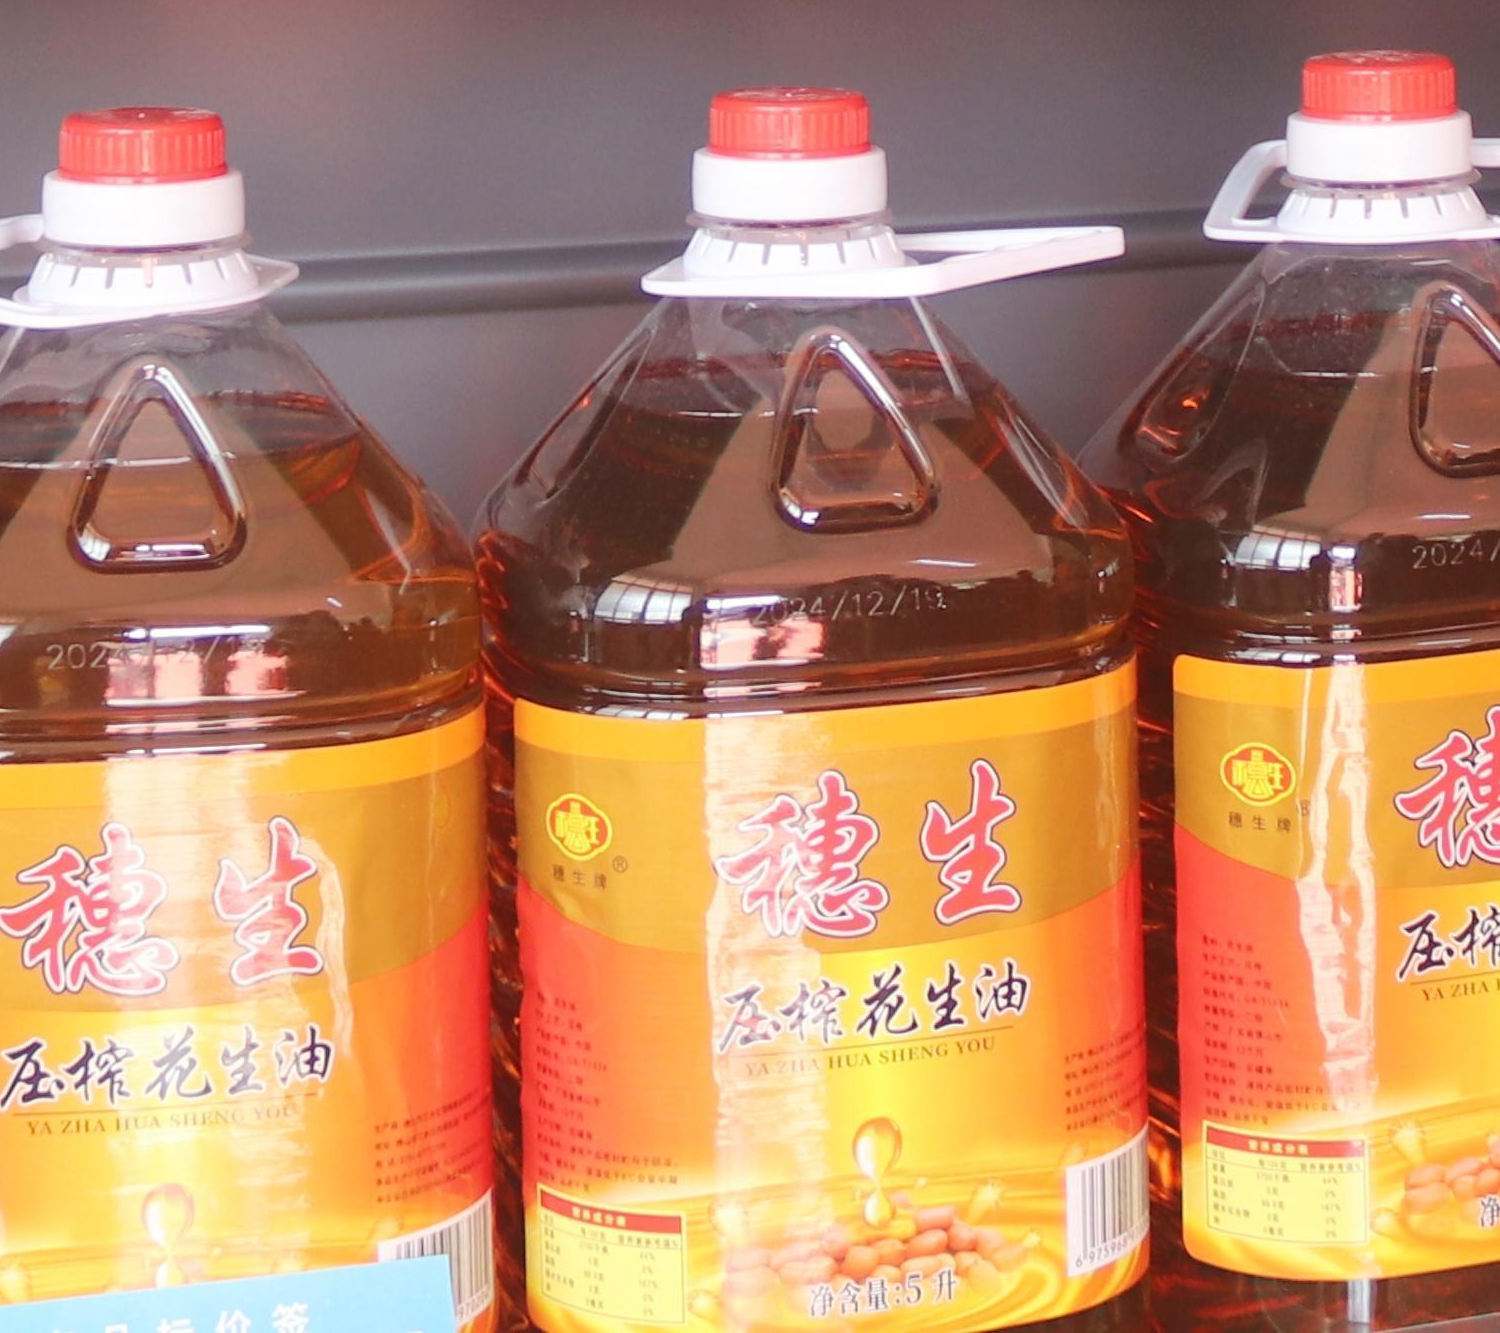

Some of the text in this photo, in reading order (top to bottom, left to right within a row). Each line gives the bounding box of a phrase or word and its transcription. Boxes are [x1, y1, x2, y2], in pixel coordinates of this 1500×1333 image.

[1229, 812, 1291, 834] 穗生牌
[715, 759, 1021, 938] 穗生
[552, 865, 608, 889] 穗生牌
[719, 960, 1030, 1053] 压榨花生油
[1421, 987, 1445, 1003] YA
[1451, 980, 1489, 998] ZHA
[745, 1037, 995, 1076] YA ZHA HUA SHENG YOU
[27, 1101, 297, 1136] YA ZHA HUA SHENG YOU
[809, 1271, 957, 1317] 净含量:5升
